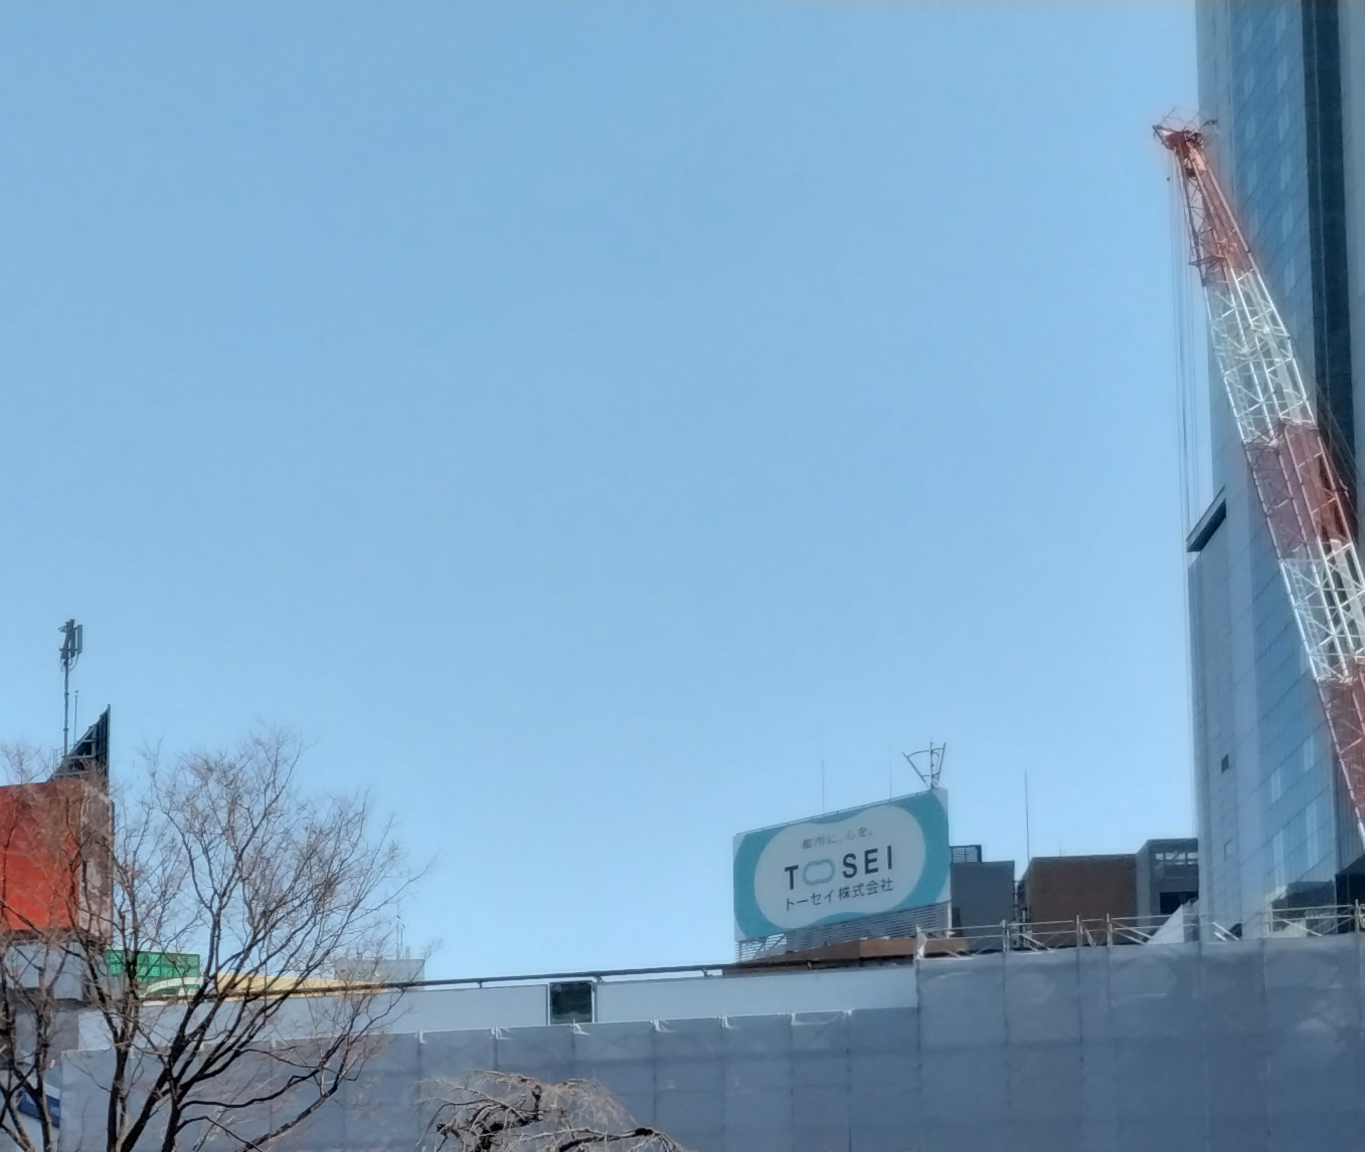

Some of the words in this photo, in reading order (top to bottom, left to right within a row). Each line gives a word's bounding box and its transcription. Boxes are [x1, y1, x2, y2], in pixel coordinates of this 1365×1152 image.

[786, 877, 894, 911] トーセイ株式会社
